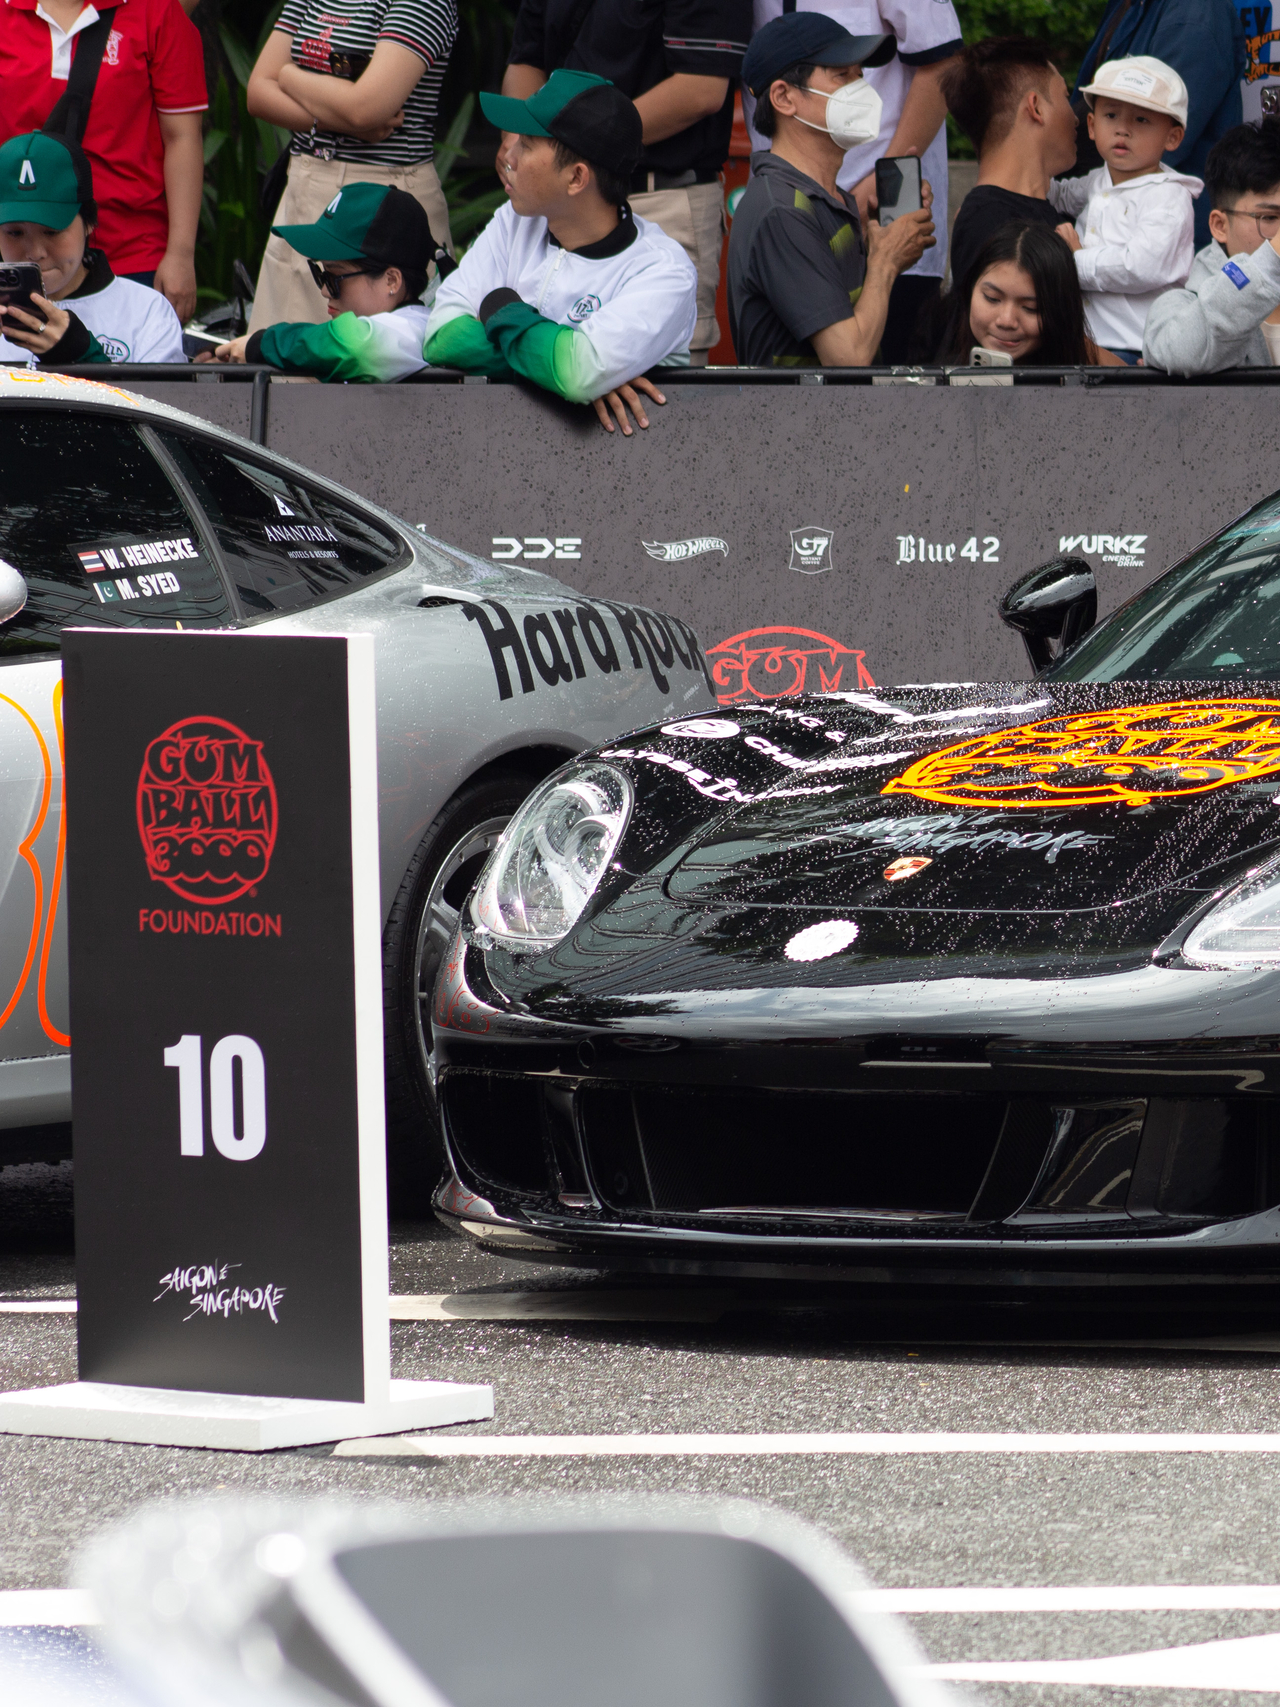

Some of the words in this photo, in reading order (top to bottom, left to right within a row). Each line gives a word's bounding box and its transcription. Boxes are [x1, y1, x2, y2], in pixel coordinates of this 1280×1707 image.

[264, 525, 339, 543] ANANTARA
[663, 544, 690, 560] HOT
[688, 539, 725, 556] WHEELS
[794, 537, 829, 556] G7
[896, 534, 957, 565] Blue
[960, 536, 1000, 562] 42
[1060, 535, 1148, 554] WURKZ
[99, 549, 124, 571] W.
[120, 537, 200, 567] HEINECKE
[287, 550, 310, 559] HOTELS
[315, 550, 339, 559] RESORTS
[114, 577, 140, 601] M.
[137, 571, 181, 597] SYED
[460, 595, 622, 701] Hard
[597, 598, 716, 697] Rock
[144, 732, 265, 786] GUM
[143, 785, 271, 835] BALL
[139, 909, 282, 937] FOUNDATION
[163, 1034, 267, 1161] 10
[153, 1259, 219, 1302] SAIGON
[183, 1283, 288, 1324] SINGAPORE
